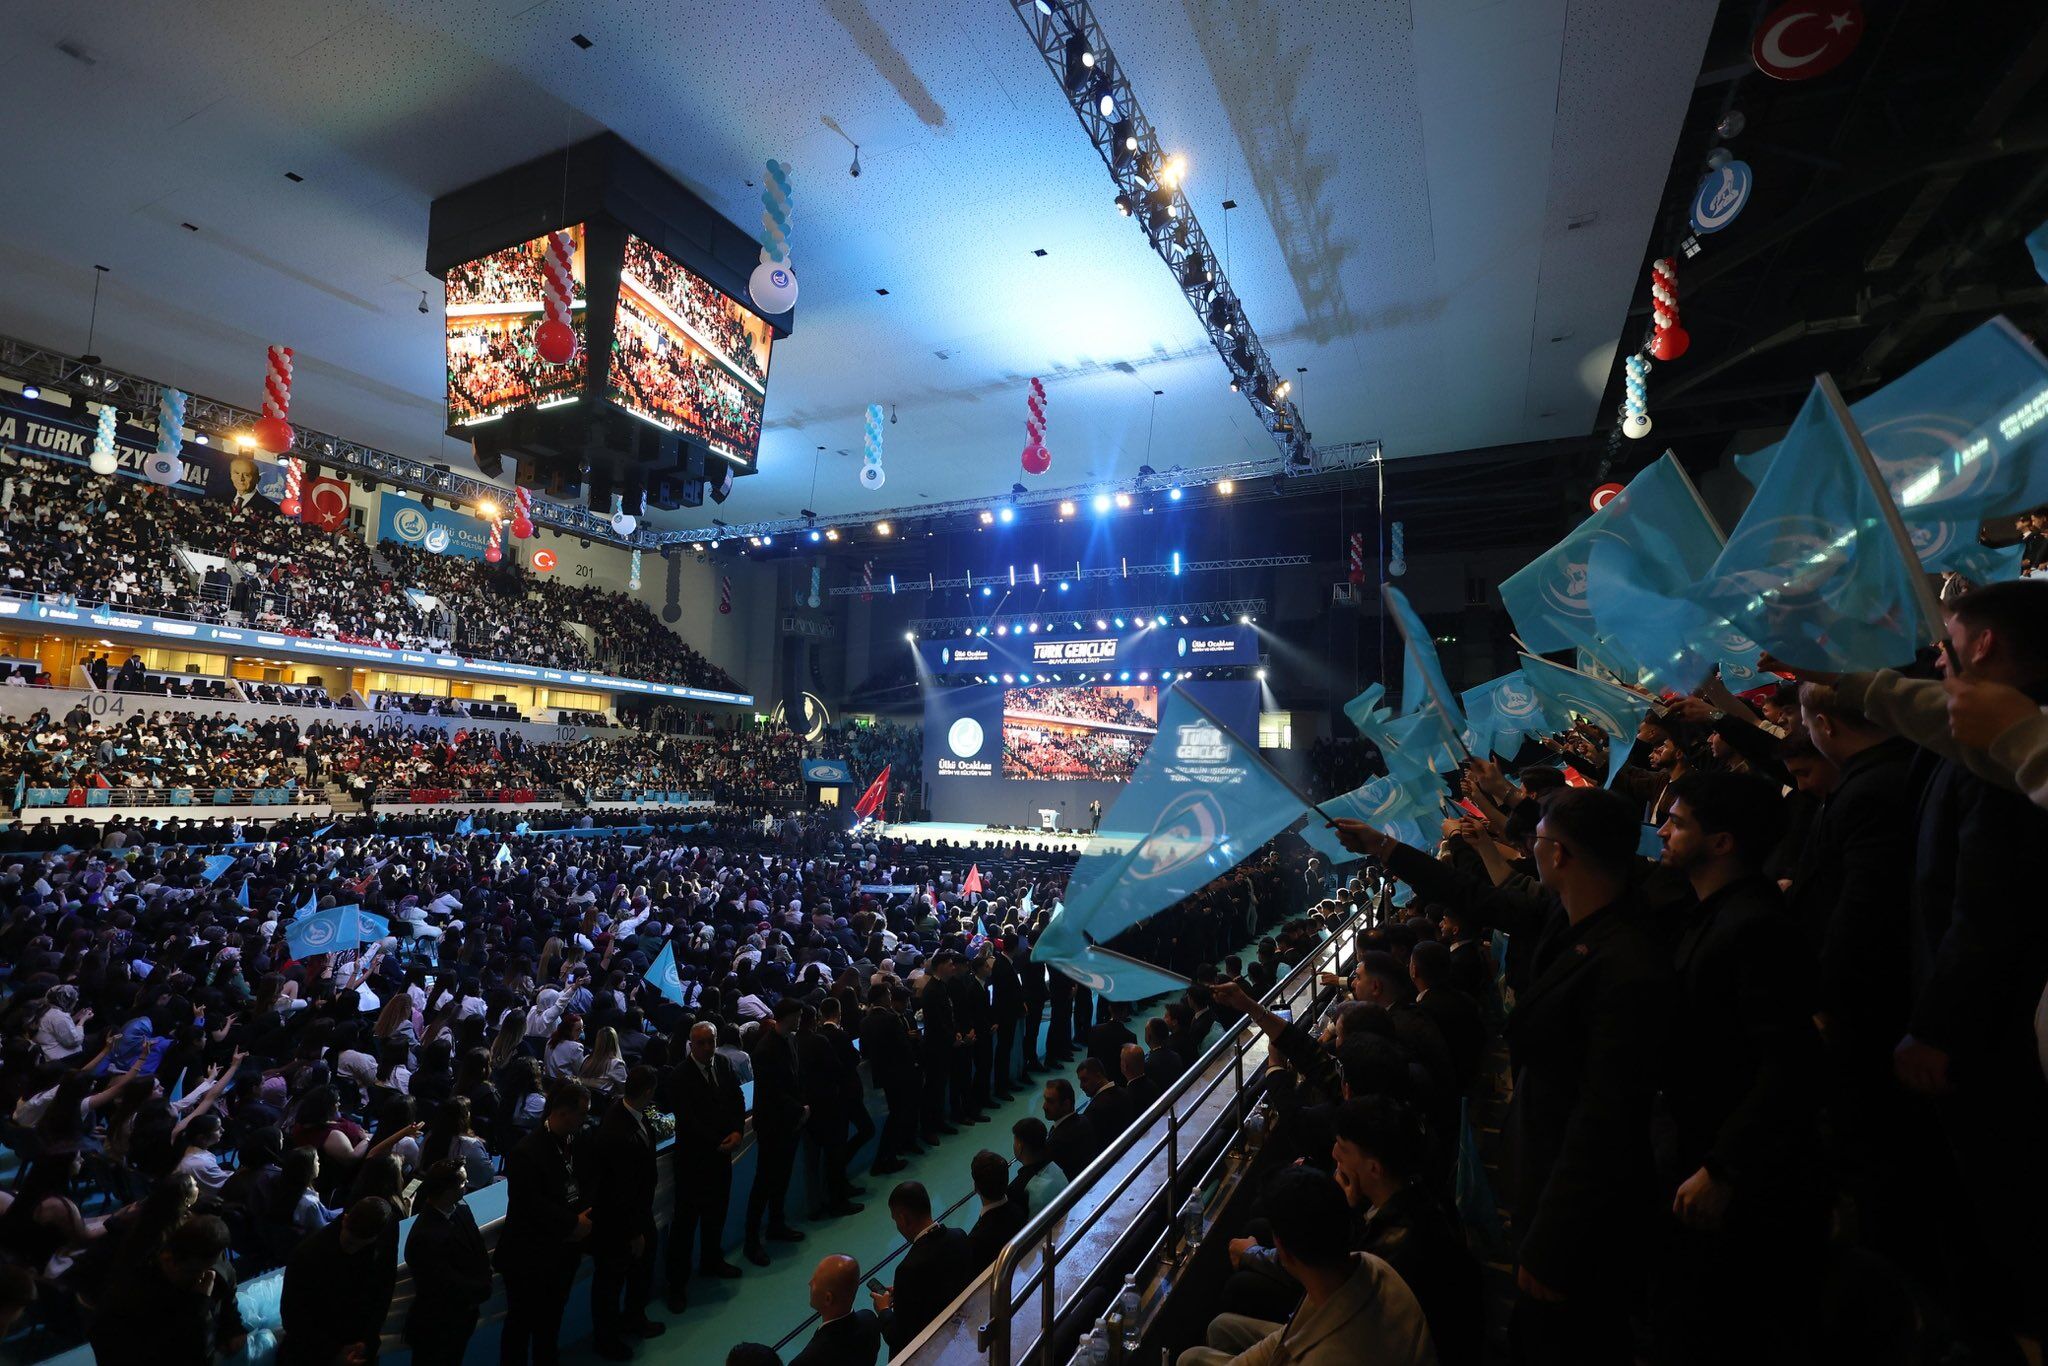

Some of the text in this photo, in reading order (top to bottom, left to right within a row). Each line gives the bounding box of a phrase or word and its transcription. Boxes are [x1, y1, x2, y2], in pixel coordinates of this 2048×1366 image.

[26, 421, 88, 456] TÜRK
[575, 564, 594, 579] 201
[1033, 643, 1064, 659] TÜRK
[81, 694, 125, 716] 104
[555, 726, 576, 741] 102
[938, 758, 956, 770] Ülkü
